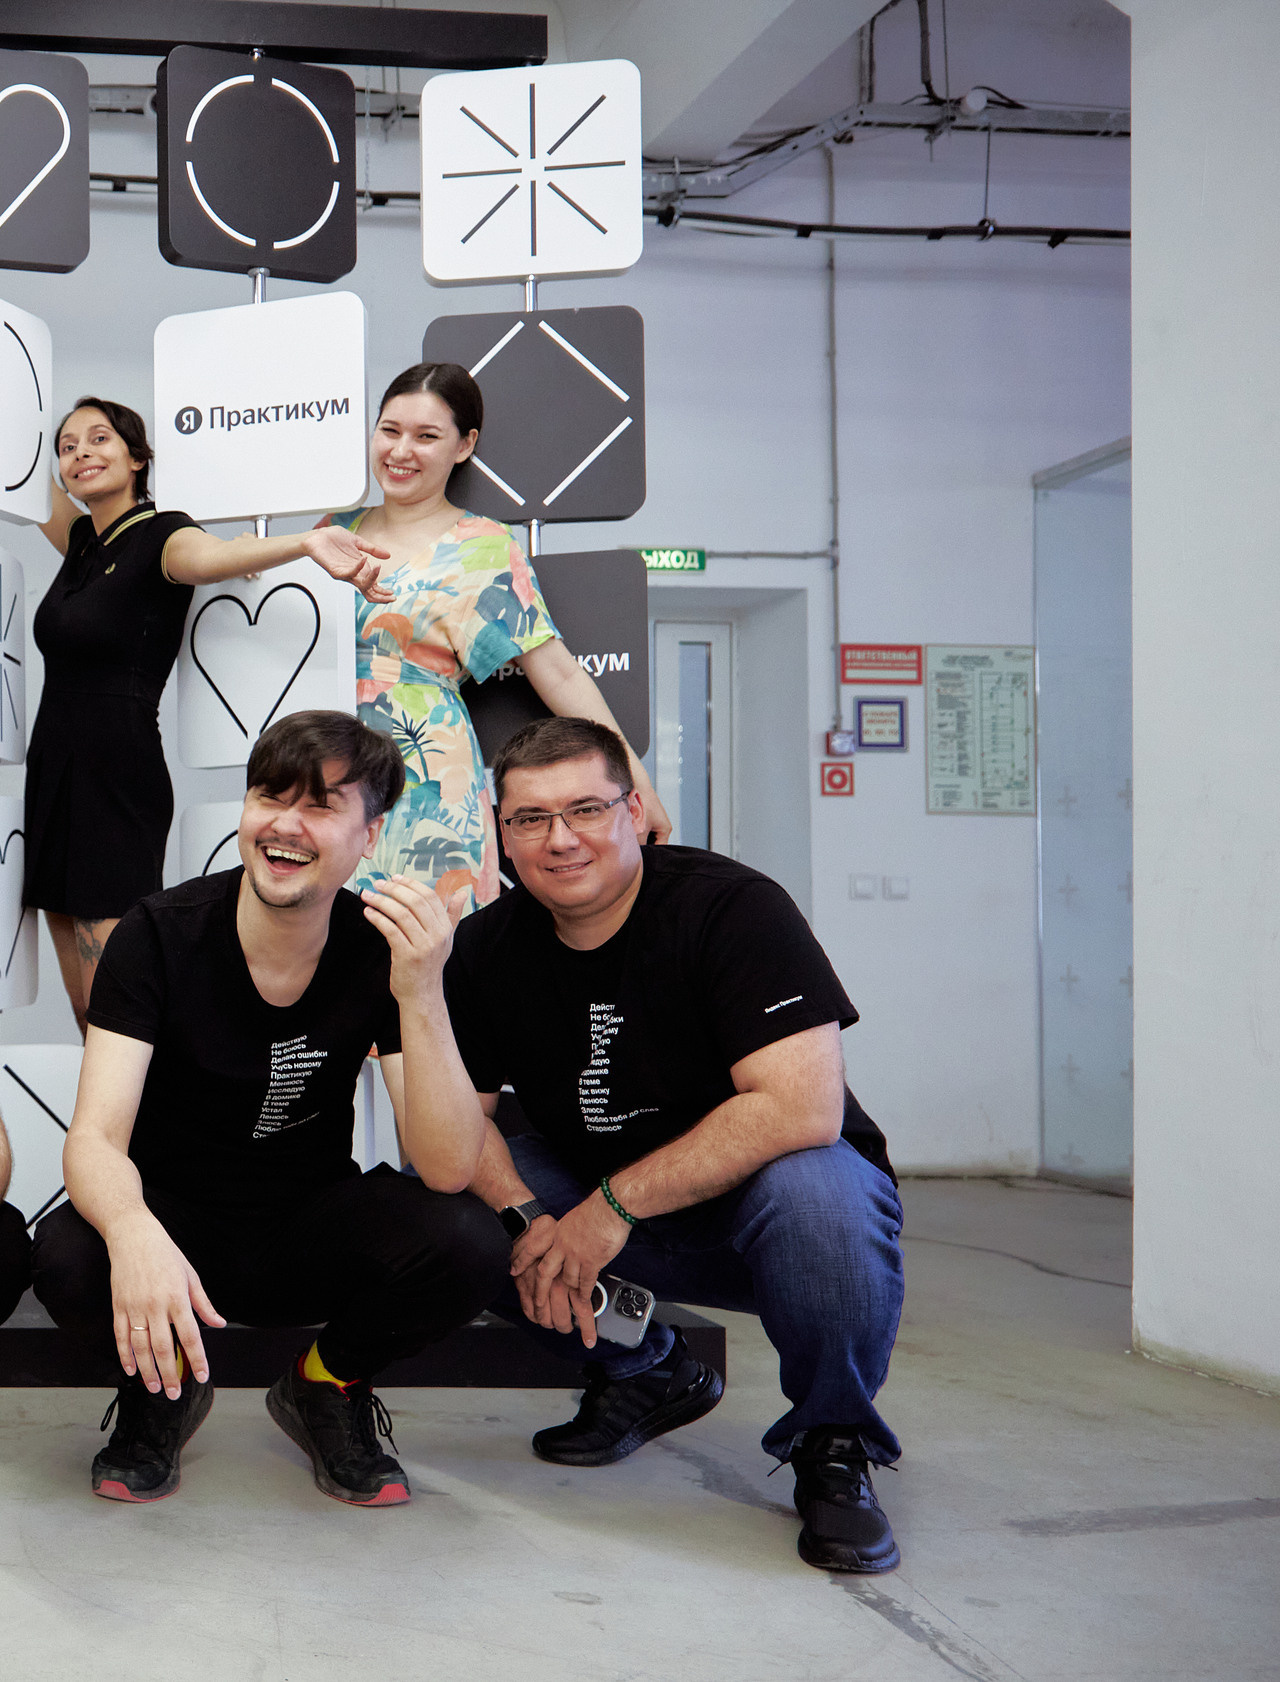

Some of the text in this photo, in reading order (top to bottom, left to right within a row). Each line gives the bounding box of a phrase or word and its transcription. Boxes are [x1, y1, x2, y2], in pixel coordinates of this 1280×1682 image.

[210, 397, 350, 431] Практикум
[641, 550, 700, 569] ЫХОД
[590, 1013, 602, 1021] Не
[271, 1035, 307, 1049] Действую
[283, 1044, 307, 1054] боюсь
[271, 1050, 328, 1064] Делаю ошибки
[271, 1061, 322, 1071] Учусь новому
[271, 1071, 313, 1080] Практикую
[584, 1115, 609, 1123] Люблю
[609, 1114, 628, 1123] тебя
[629, 1110, 639, 1118] до
[586, 1124, 622, 1132] Стараюсь
